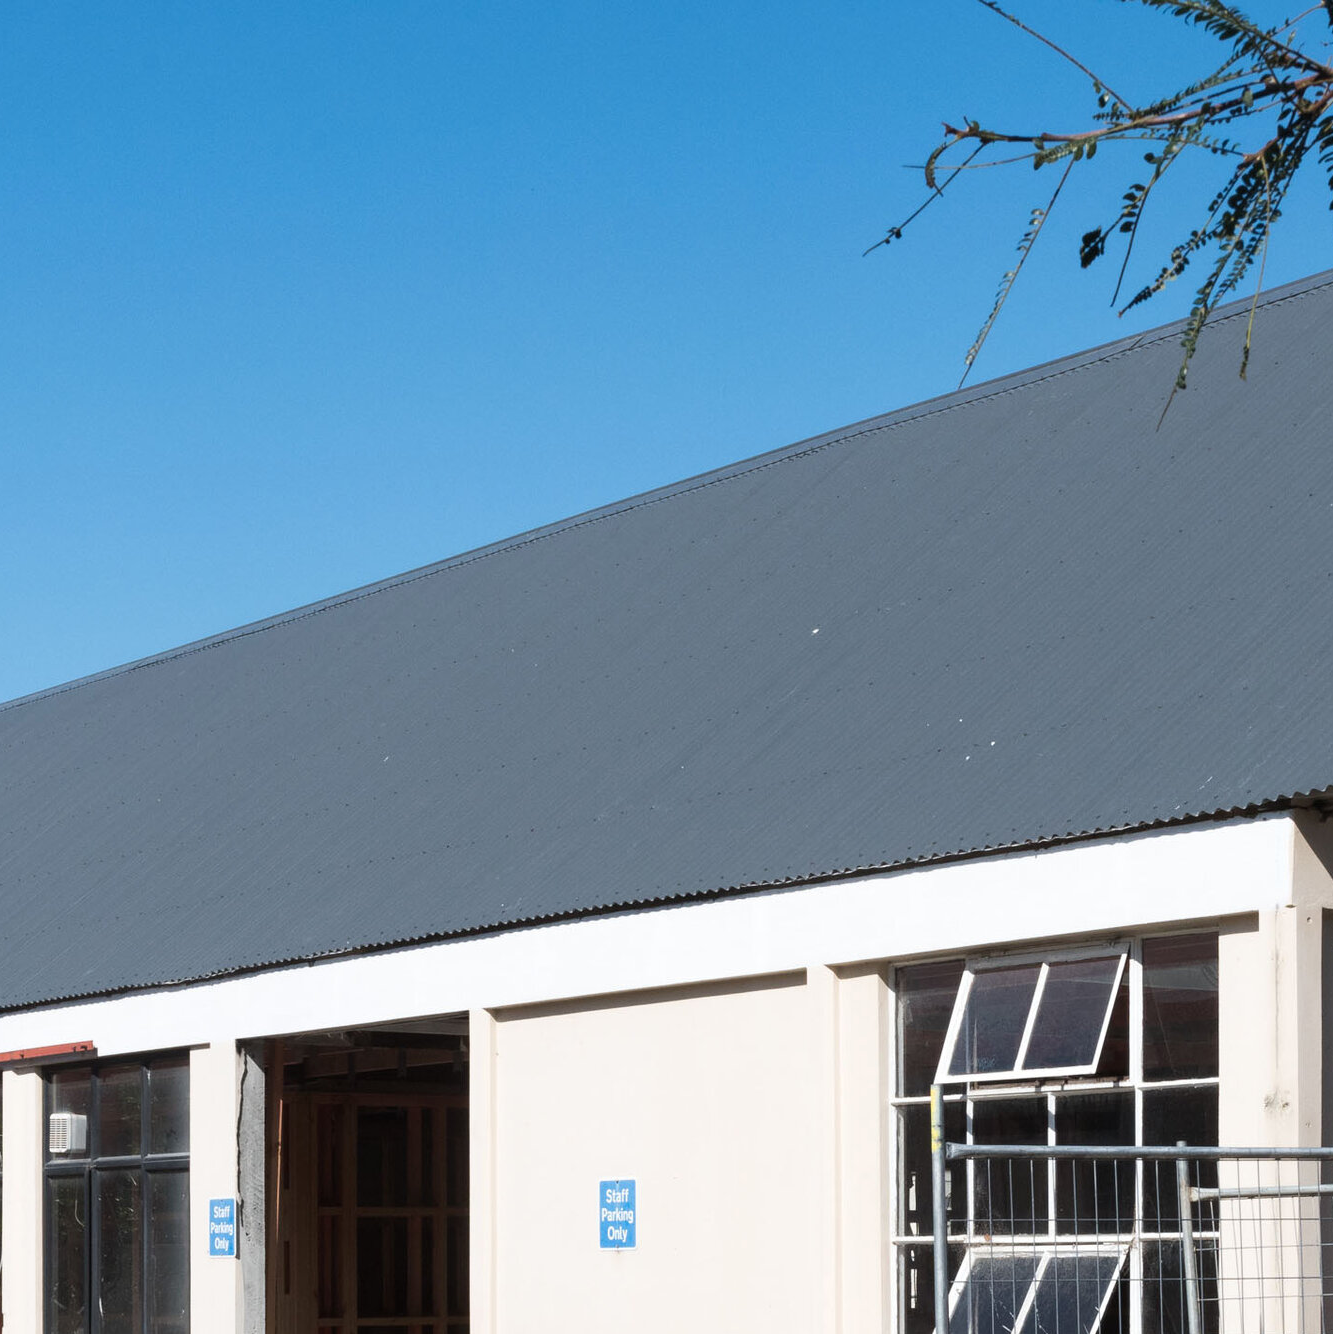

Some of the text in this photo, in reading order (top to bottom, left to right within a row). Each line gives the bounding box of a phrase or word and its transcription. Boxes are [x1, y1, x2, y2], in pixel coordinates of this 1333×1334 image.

[606, 1188, 629, 1203] Staff
[213, 1205, 231, 1218] Staff
[601, 1207, 634, 1224] Parking
[210, 1222, 234, 1236] Parking
[607, 1226, 628, 1243] Only
[214, 1237, 229, 1251] Only
